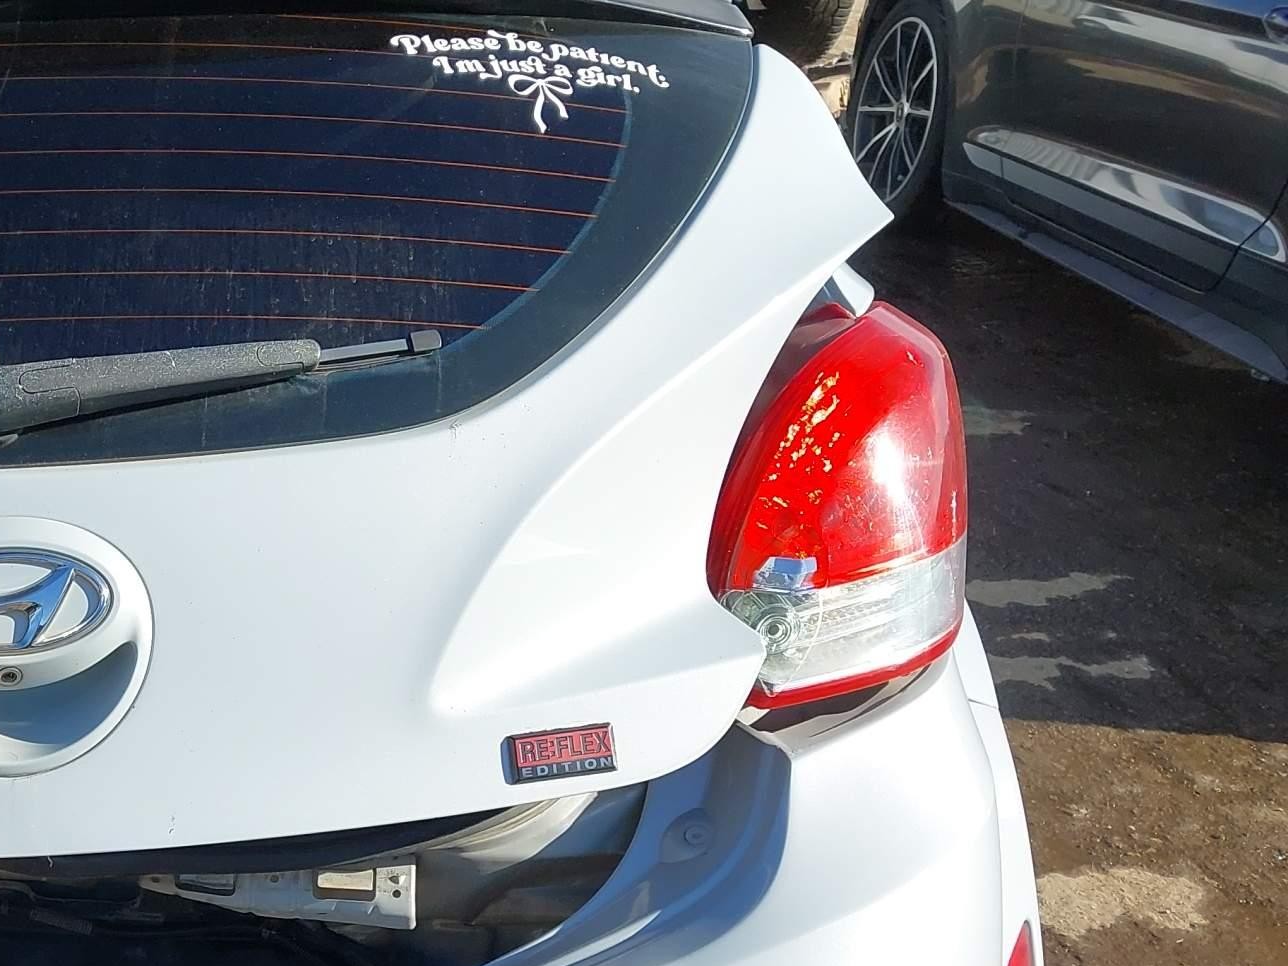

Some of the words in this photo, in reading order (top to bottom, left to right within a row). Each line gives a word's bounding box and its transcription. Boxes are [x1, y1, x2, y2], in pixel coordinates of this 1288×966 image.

[390, 33, 502, 55] Please
[487, 29, 544, 53] be
[479, 54, 547, 80] just
[553, 63, 573, 78] a
[575, 65, 641, 93] girl.
[518, 730, 611, 764] RE:FLEX
[521, 756, 612, 778] EDITION
